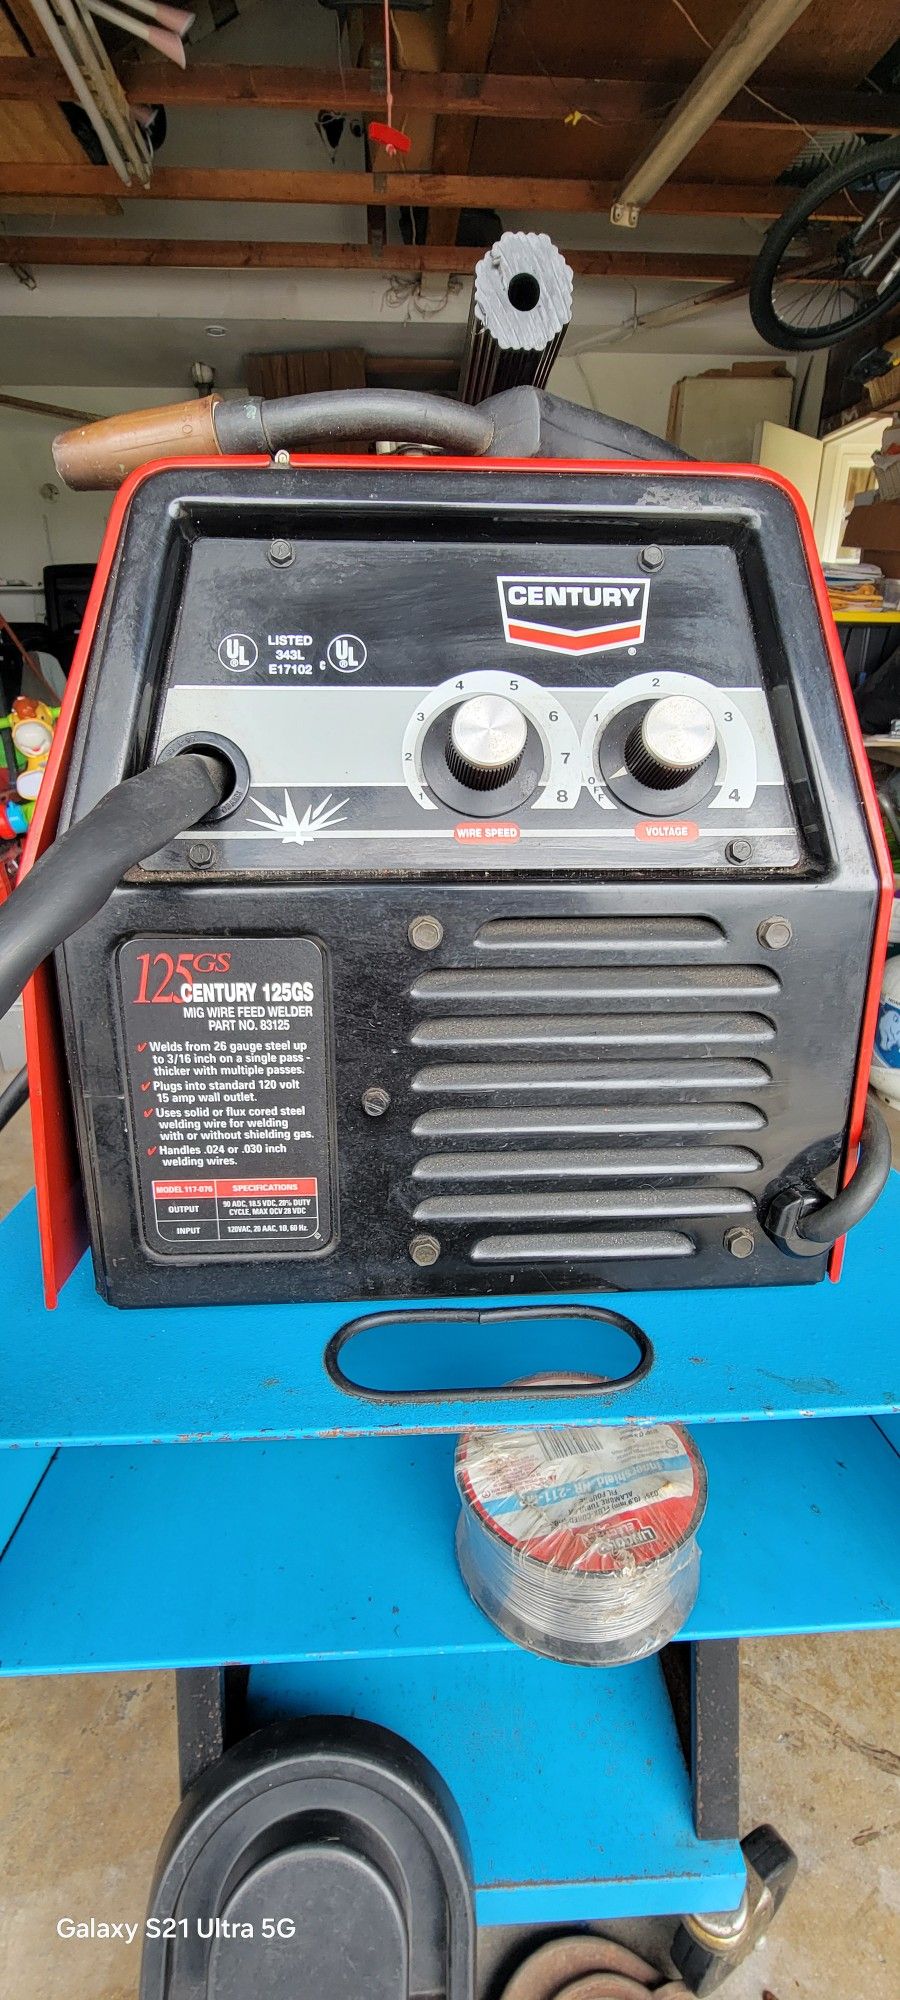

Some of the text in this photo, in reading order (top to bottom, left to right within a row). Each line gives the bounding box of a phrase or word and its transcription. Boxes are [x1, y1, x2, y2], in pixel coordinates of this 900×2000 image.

[507, 585, 641, 608] CENTURY
[268, 635, 313, 646] LISTED
[275, 650, 305, 660] 343L
[268, 664, 313, 674] E17102
[455, 680, 464, 690] 4
[509, 680, 519, 691] 5
[651, 678, 661, 688] 2
[416, 711, 425, 722] 3
[548, 710, 559, 722] 6
[594, 714, 599, 722] 1
[723, 711, 733, 722] 3
[404, 752, 413, 761] 2
[560, 752, 571, 764] 7
[418, 792, 424, 800] 1
[556, 790, 569, 803] 8
[728, 788, 741, 802] 4
[456, 828, 518, 838] WIRE SPEED
[644, 827, 688, 837] VOLTAGE
[180, 982, 314, 1003] CENTURY 125GS
[183, 1006, 313, 1018] MIG WIRE FEED WELDER
[208, 1020, 290, 1031] PART NO. 83125
[149, 1040, 308, 1053] Welds from 26 gauge steel up
[152, 1054, 165, 1064] to
[166, 1054, 191, 1064] 3/16
[194, 1053, 218, 1064] inch
[220, 1055, 234, 1063] on
[236, 1054, 243, 1063] a
[245, 1052, 277, 1065] single
[280, 1054, 304, 1064] pass
[154, 1065, 306, 1077] thicker with multiple passes.
[153, 1080, 300, 1093] Plugs into standard 120 volt
[156, 1092, 258, 1104] 15 amp wall outlet.
[155, 1106, 306, 1118] Uses solid or flux cored steel
[158, 1118, 289, 1130] welding wire for welding
[160, 1130, 314, 1141] with or without shielding gas.
[159, 1144, 287, 1155] Handles .024 or .030 inch
[162, 1156, 238, 1168] welding wires.
[156, 1186, 184, 1194] MODEL
[232, 1184, 298, 1192] SPECIFICATIONS
[222, 1200, 230, 1208] 90
[293, 1198, 311, 1206] DUTY
[168, 1205, 200, 1214] OUTPUT
[290, 1224, 298, 1232] 60
